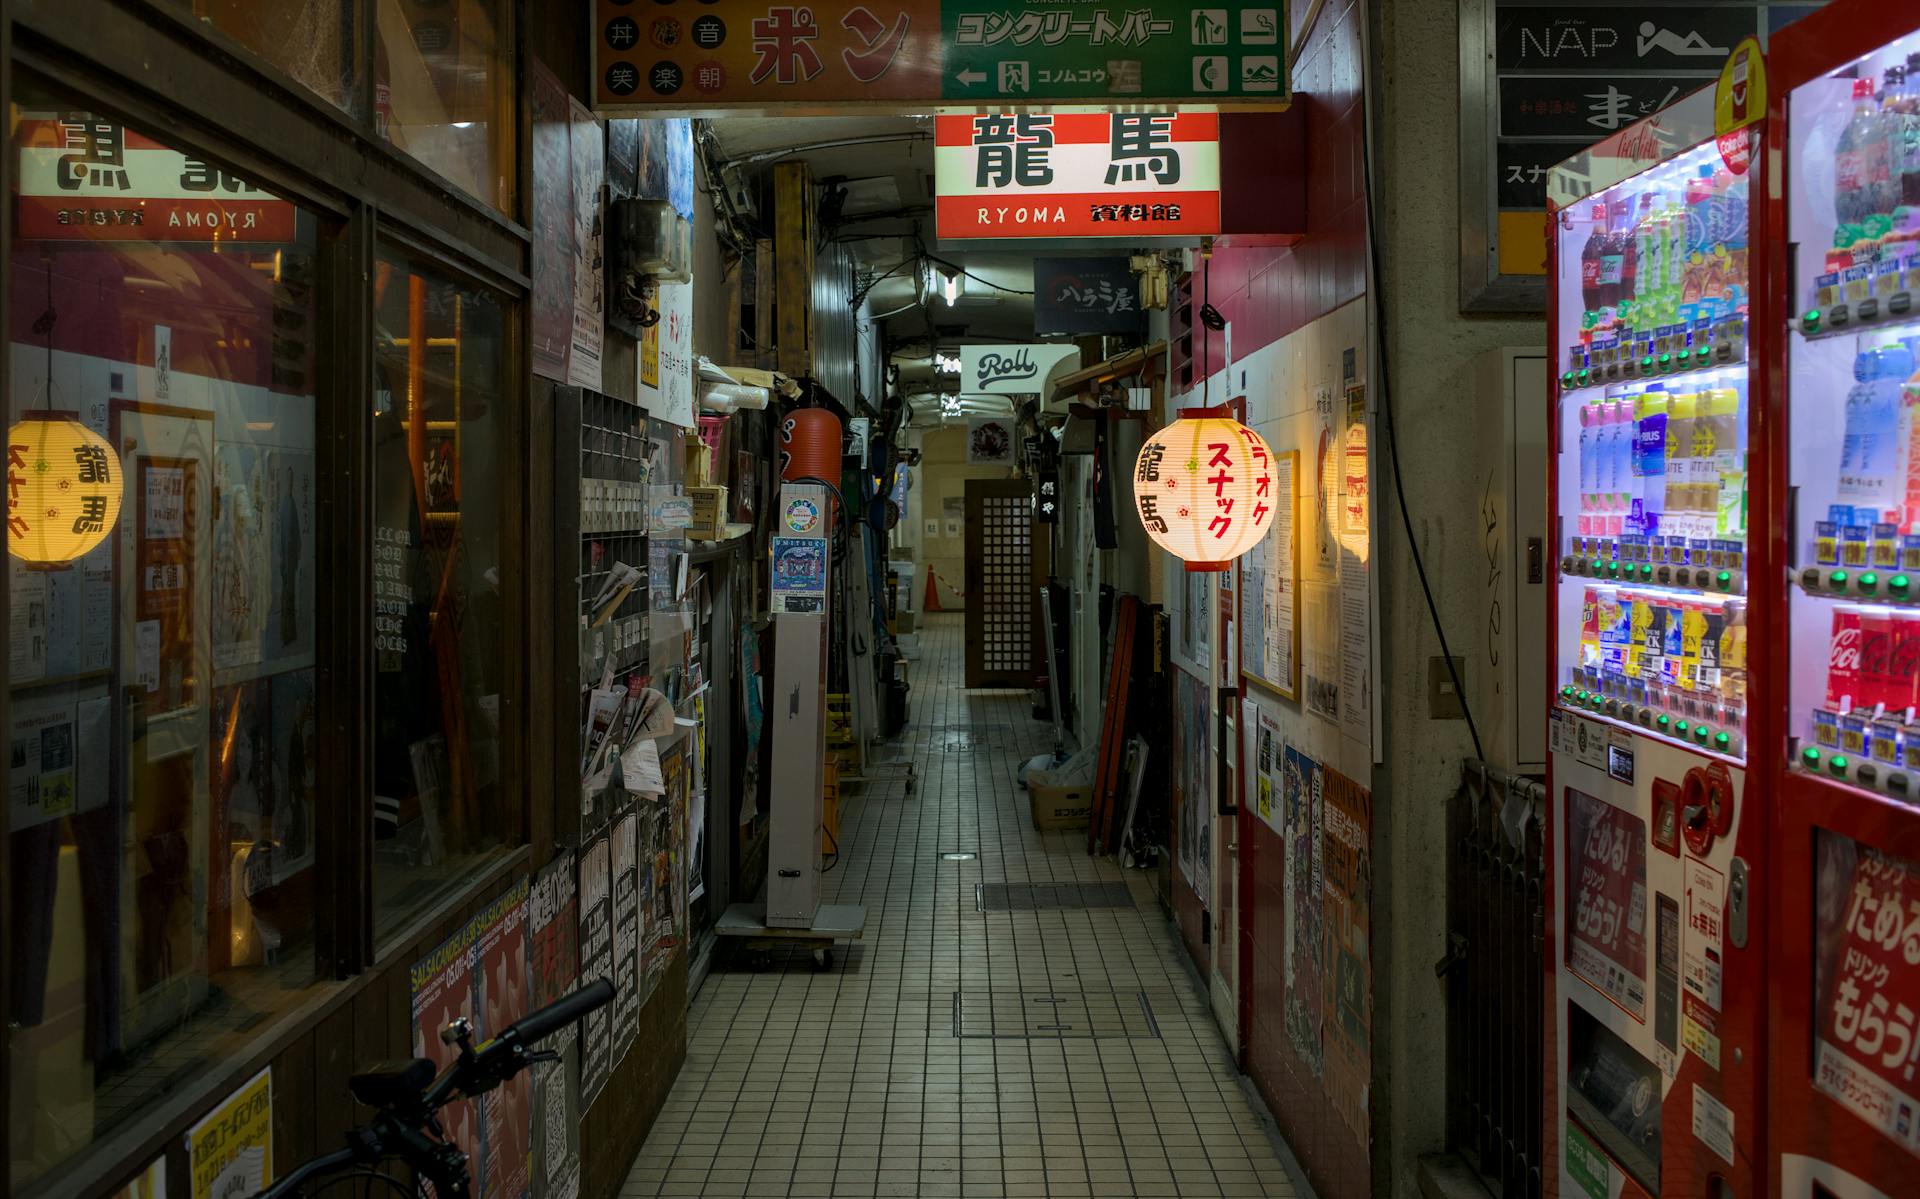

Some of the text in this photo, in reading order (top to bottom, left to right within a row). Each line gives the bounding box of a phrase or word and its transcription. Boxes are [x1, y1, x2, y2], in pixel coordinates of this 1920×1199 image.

[611, 24, 632, 44] 丼
[697, 22, 720, 43] 音
[955, 9, 1173, 47] コンクリートバー
[1521, 28, 1618, 57] NAP
[611, 68, 633, 89] 笑
[655, 69, 677, 88] 楽
[699, 67, 720, 88] 朝
[972, 113, 1180, 188] 龍馬
[976, 207, 1066, 224] RYOMA
[1090, 203, 1180, 222] 資料館
[1057, 280, 1134, 314] ハラミ屋
[977, 348, 1038, 386] Roll
[1138, 443, 1168, 535] 龍馬
[1208, 443, 1235, 539] スナック
[1239, 427, 1271, 526] カラオケ
[1843, 946, 1890, 989] ドリンク
